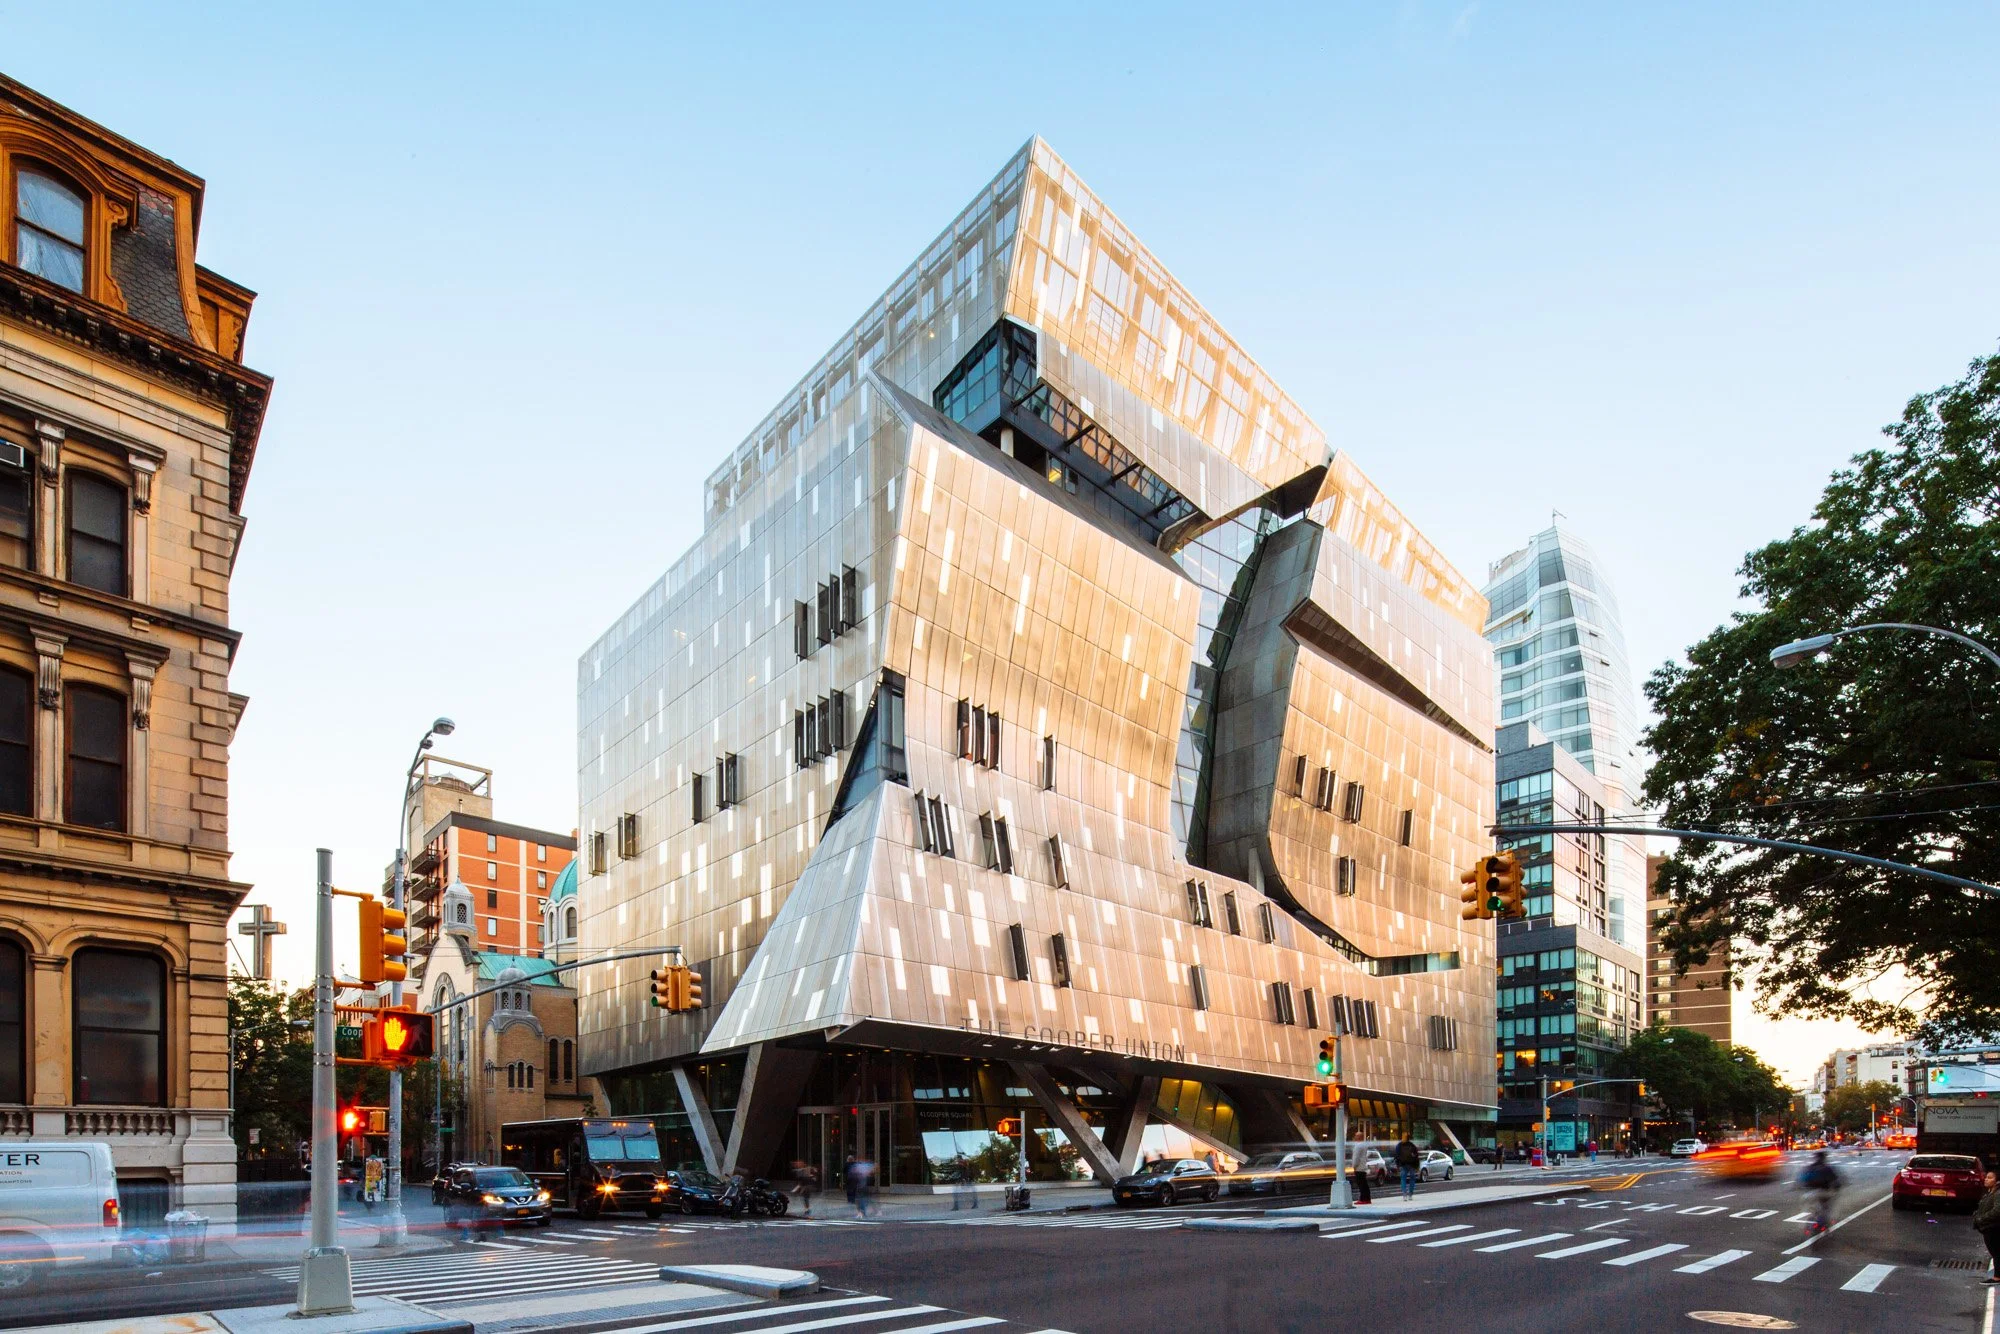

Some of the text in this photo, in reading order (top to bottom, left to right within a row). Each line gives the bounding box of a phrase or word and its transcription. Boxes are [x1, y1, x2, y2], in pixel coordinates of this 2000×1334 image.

[961, 1017, 1185, 1064] THE COOPER UNION
[1928, 1107, 1959, 1115] NOVA
[1532, 1197, 1820, 1224] SCHOOL
